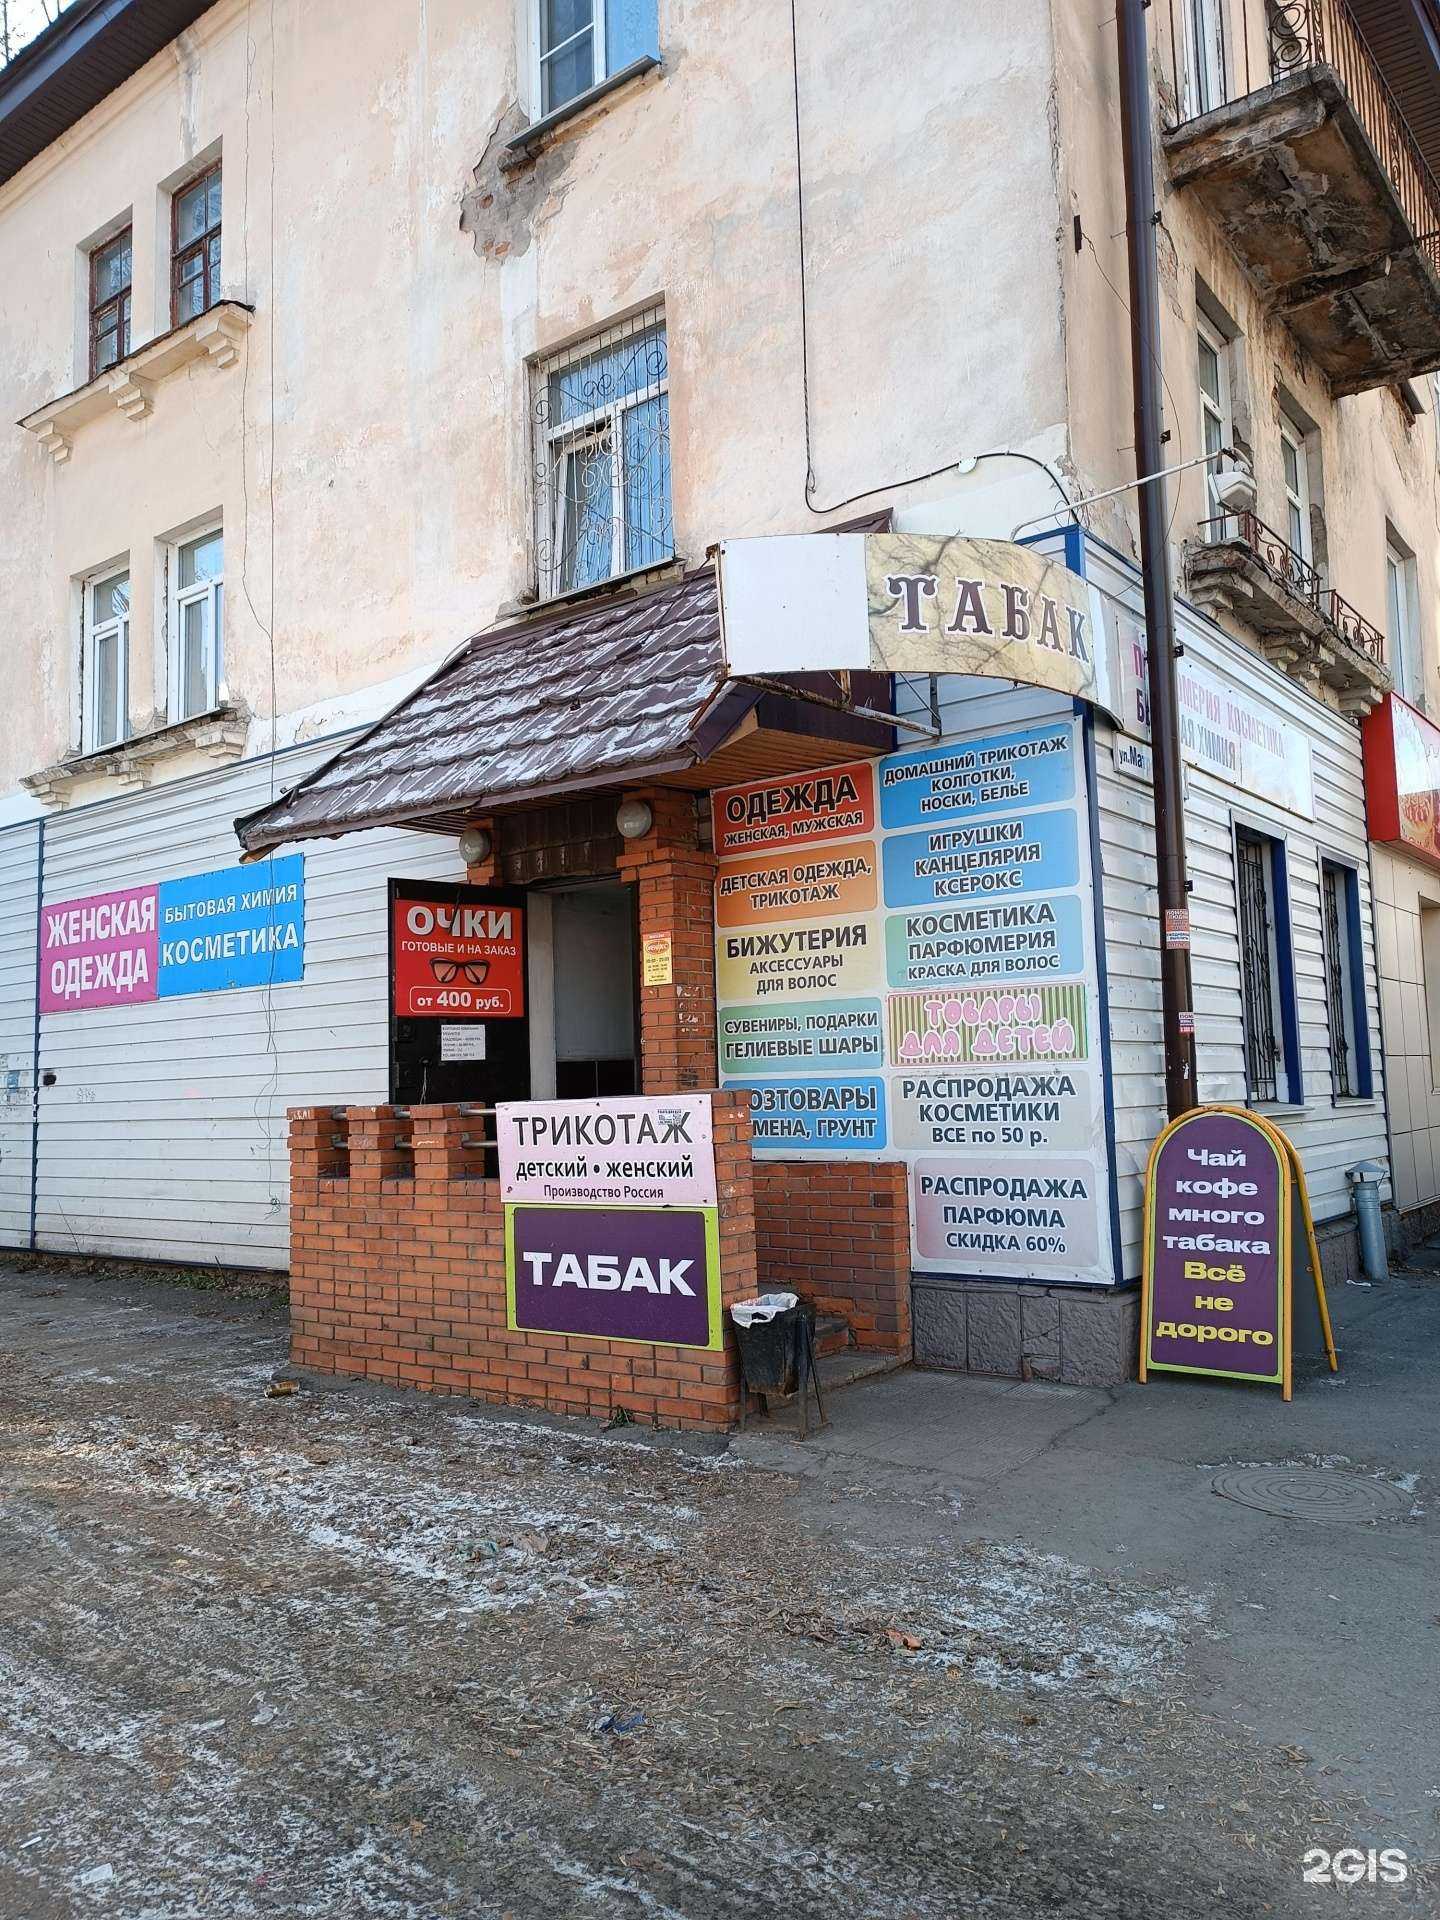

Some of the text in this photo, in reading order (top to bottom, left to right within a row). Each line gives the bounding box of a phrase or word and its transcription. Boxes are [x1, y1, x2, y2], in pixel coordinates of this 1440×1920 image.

[887, 577, 1089, 663] ТАБАК
[1197, 723, 1236, 771] ХИМИЯ
[885, 736, 1067, 785] ДОМАШНИЙ ТРИКОТАЖ
[931, 767, 1015, 792] КОЛГОТКИ,
[727, 775, 858, 824] ОДЕЖДА
[921, 782, 1029, 812] НОСКИ, БЕЛЬЕ
[724, 811, 863, 846] ЖЕНСКАЯ, МУЖСКАЯ
[930, 824, 1022, 851] ИГРУШКИ
[915, 845, 1040, 876] КАНЦЕЛЯРИЯ
[720, 858, 872, 894] ДЕТСКАЯ ОДЕЖДА,
[934, 871, 1022, 896] КСЕРОКС
[165, 884, 297, 923] БЫТОВАЯ ХИМИЯ
[750, 883, 839, 909] ТРИКОТАЖ
[47, 896, 156, 948] ЖЕНСКАЯ
[407, 906, 512, 939] ОЧКИ
[907, 902, 1054, 936] КОСМЕТИКА
[162, 922, 298, 967] КОСМЕТИКА
[401, 941, 516, 956] ГОТОВЫЕ И НА ЗАКАЗ
[727, 925, 867, 957] БИЖУТЕРИЯ
[909, 931, 1055, 959] ПАРФЮМЕРИЯ
[51, 948, 149, 1000] ОДЕЖДА
[750, 955, 843, 975] АКСЕССУАРЫ
[908, 954, 1059, 980] КРАСКА ДЛЯ ВОЛОС
[756, 974, 837, 994] ДЛЯ ВОЛОС
[417, 991, 503, 1010] от 400 руб.
[925, 995, 1040, 1027] ТОВАРЫ
[724, 1013, 878, 1034] СУВЕНИРЫ, ПОДАРКИ
[726, 1035, 878, 1059] ГЕЛИЕВЫЕ ШАРЫ
[899, 1018, 1074, 1057] ДЛЯ ДЕТЕЙ
[750, 1088, 875, 1110] ОЗТОВАРЫ
[903, 1076, 1076, 1101] РАСПРОДАЖА
[919, 1103, 1060, 1122] КОСМЕТИКИ
[513, 1112, 692, 1146] ТРИКОТАЖ
[752, 1119, 876, 1138] МЕНА, ГРУНТ
[932, 1128, 1047, 1148] ВСЕ по 50 р.
[516, 1155, 693, 1181] детский женский
[1187, 1149, 1246, 1167] Чай
[544, 1185, 664, 1200] Производство Россия
[921, 1176, 1087, 1201] РАСПРОДАЖА
[1176, 1178, 1258, 1199] кофе
[943, 1206, 1064, 1228] ПАРФЮМА
[1169, 1208, 1265, 1225] много
[946, 1233, 1066, 1253] СКИДКА 60%
[1163, 1234, 1270, 1255] табака
[524, 1252, 696, 1296] ТАБАК
[1184, 1262, 1246, 1282] Всё
[1194, 1295, 1233, 1312] не
[1156, 1321, 1273, 1345] дорого
